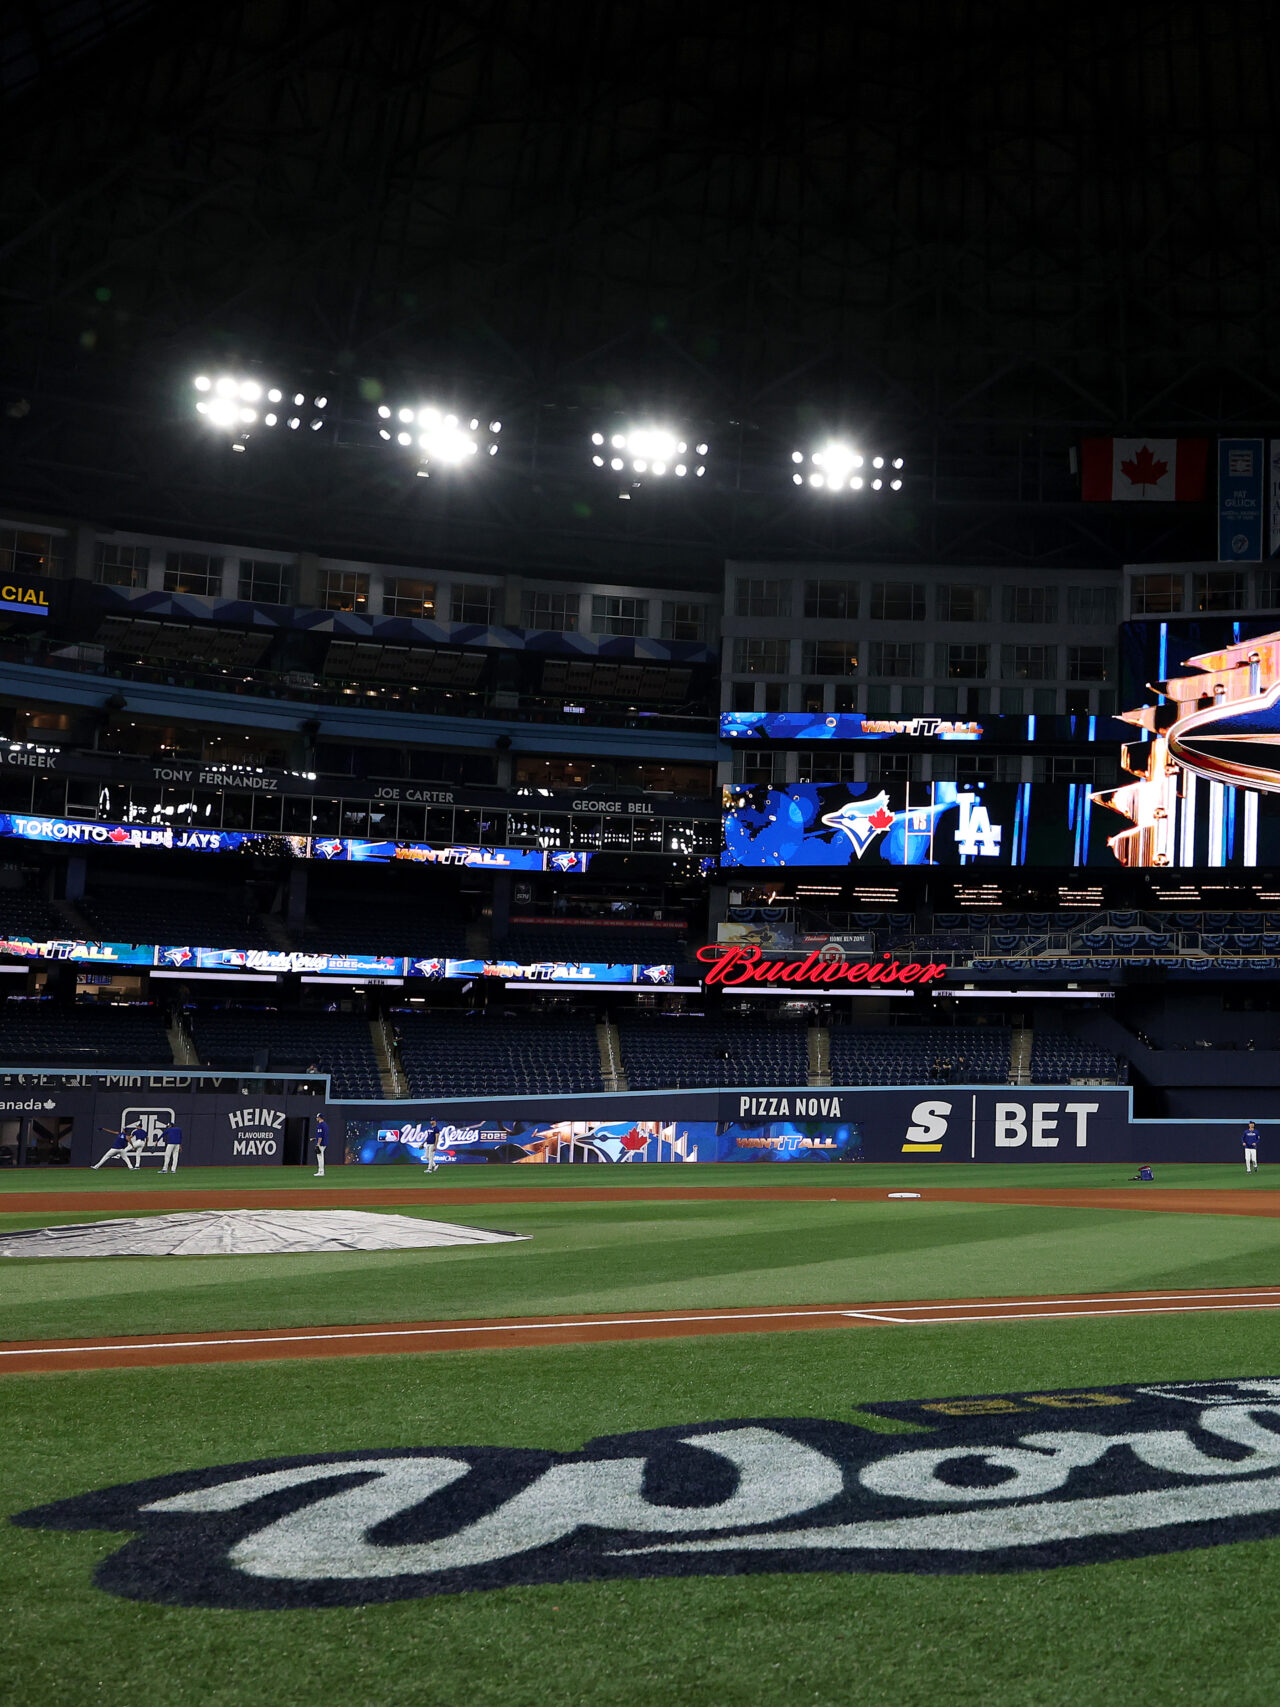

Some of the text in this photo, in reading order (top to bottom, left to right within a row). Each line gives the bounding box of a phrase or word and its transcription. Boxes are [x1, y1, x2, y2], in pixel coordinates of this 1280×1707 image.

[1, 585, 48, 605] CIAL
[8, 752, 56, 770] CHEEK
[153, 768, 278, 790] TONY FERNANDEZ
[374, 787, 454, 803] JOE CARTER
[572, 800, 654, 814] GEORGE BELL
[912, 814, 928, 830] VS
[15, 818, 108, 842] TORONTO
[177, 832, 220, 848] JAYS
[328, 960, 358, 968] 2025
[696, 944, 948, 985] Budweiser
[150, 1076, 191, 1088] LED
[740, 1096, 841, 1118] PIZZA NOVA
[228, 1108, 286, 1130] HEINZ
[994, 1102, 1100, 1148] BET
[233, 1140, 276, 1156] MAYO
[437, 1126, 478, 1150] Series
